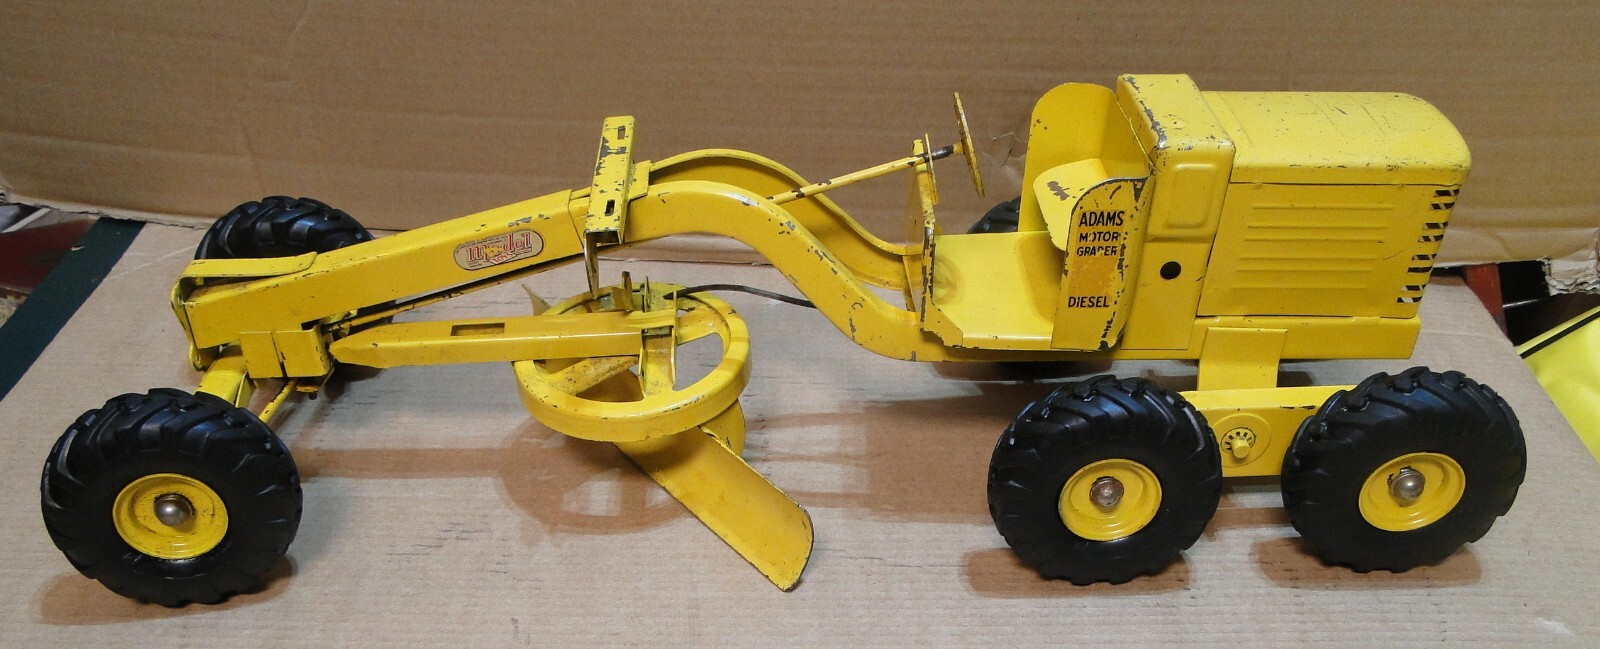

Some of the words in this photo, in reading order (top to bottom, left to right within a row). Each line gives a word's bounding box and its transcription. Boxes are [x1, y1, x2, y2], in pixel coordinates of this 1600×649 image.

[1079, 210, 1125, 227] ADAMS
[1079, 231, 1121, 242] MOTOR
[467, 232, 533, 262] Mdel
[1067, 296, 1110, 308] DIESEL
